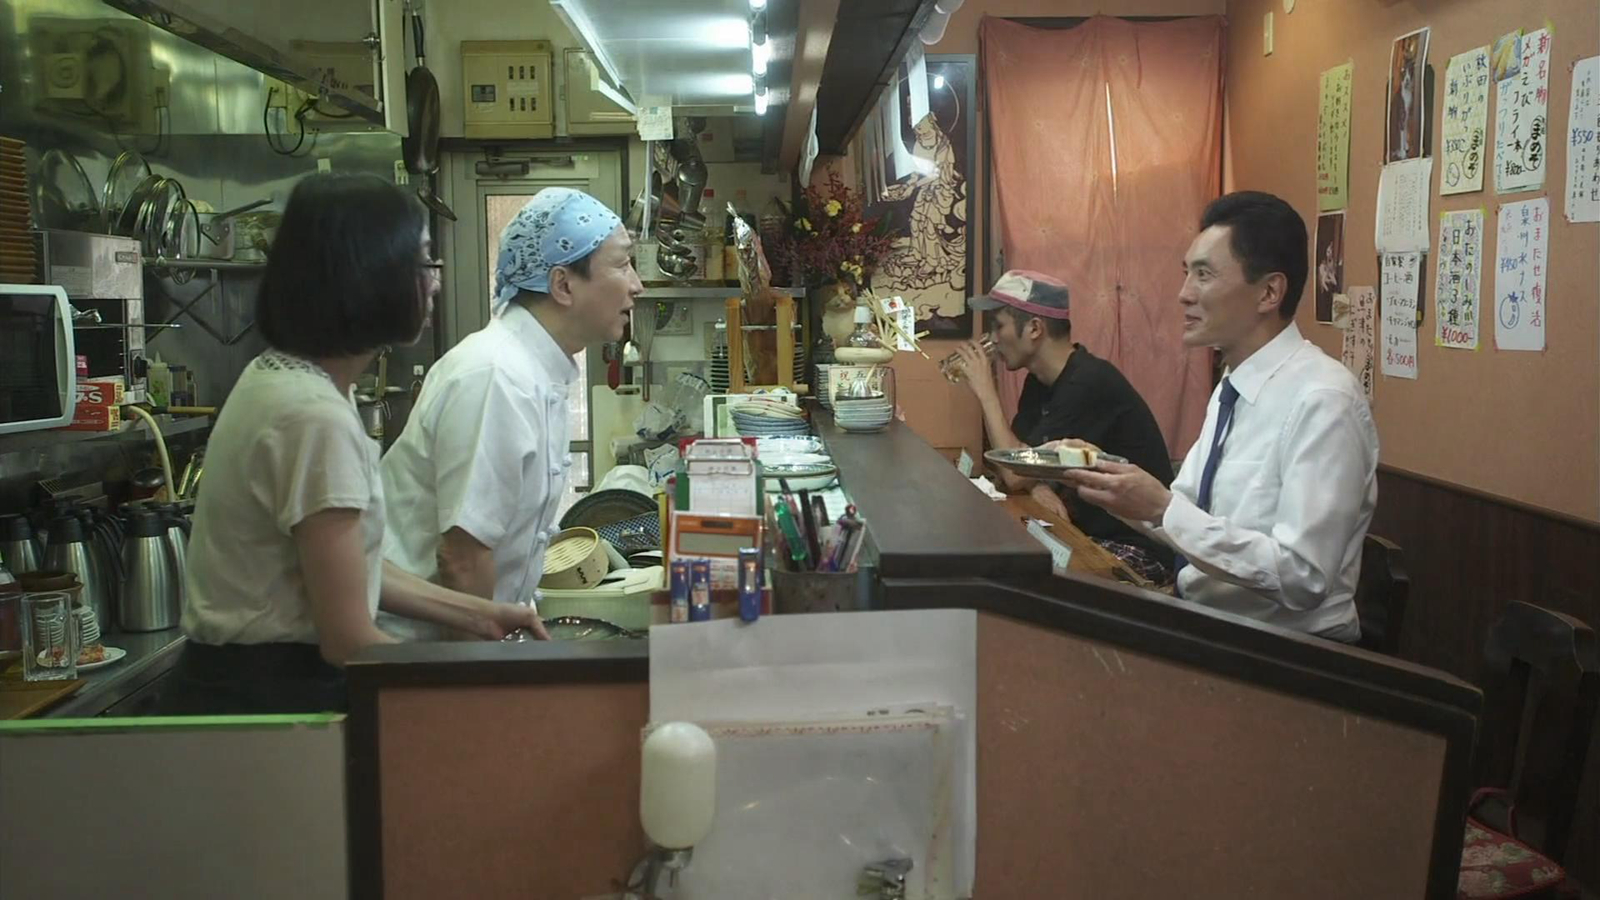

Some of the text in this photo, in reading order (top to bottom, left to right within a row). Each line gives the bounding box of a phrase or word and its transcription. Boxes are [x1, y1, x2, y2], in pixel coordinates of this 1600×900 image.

[1534, 33, 1548, 106] 新名物
[1571, 127, 1594, 147] ¥550
[1531, 206, 1543, 328] おまたせ復活
